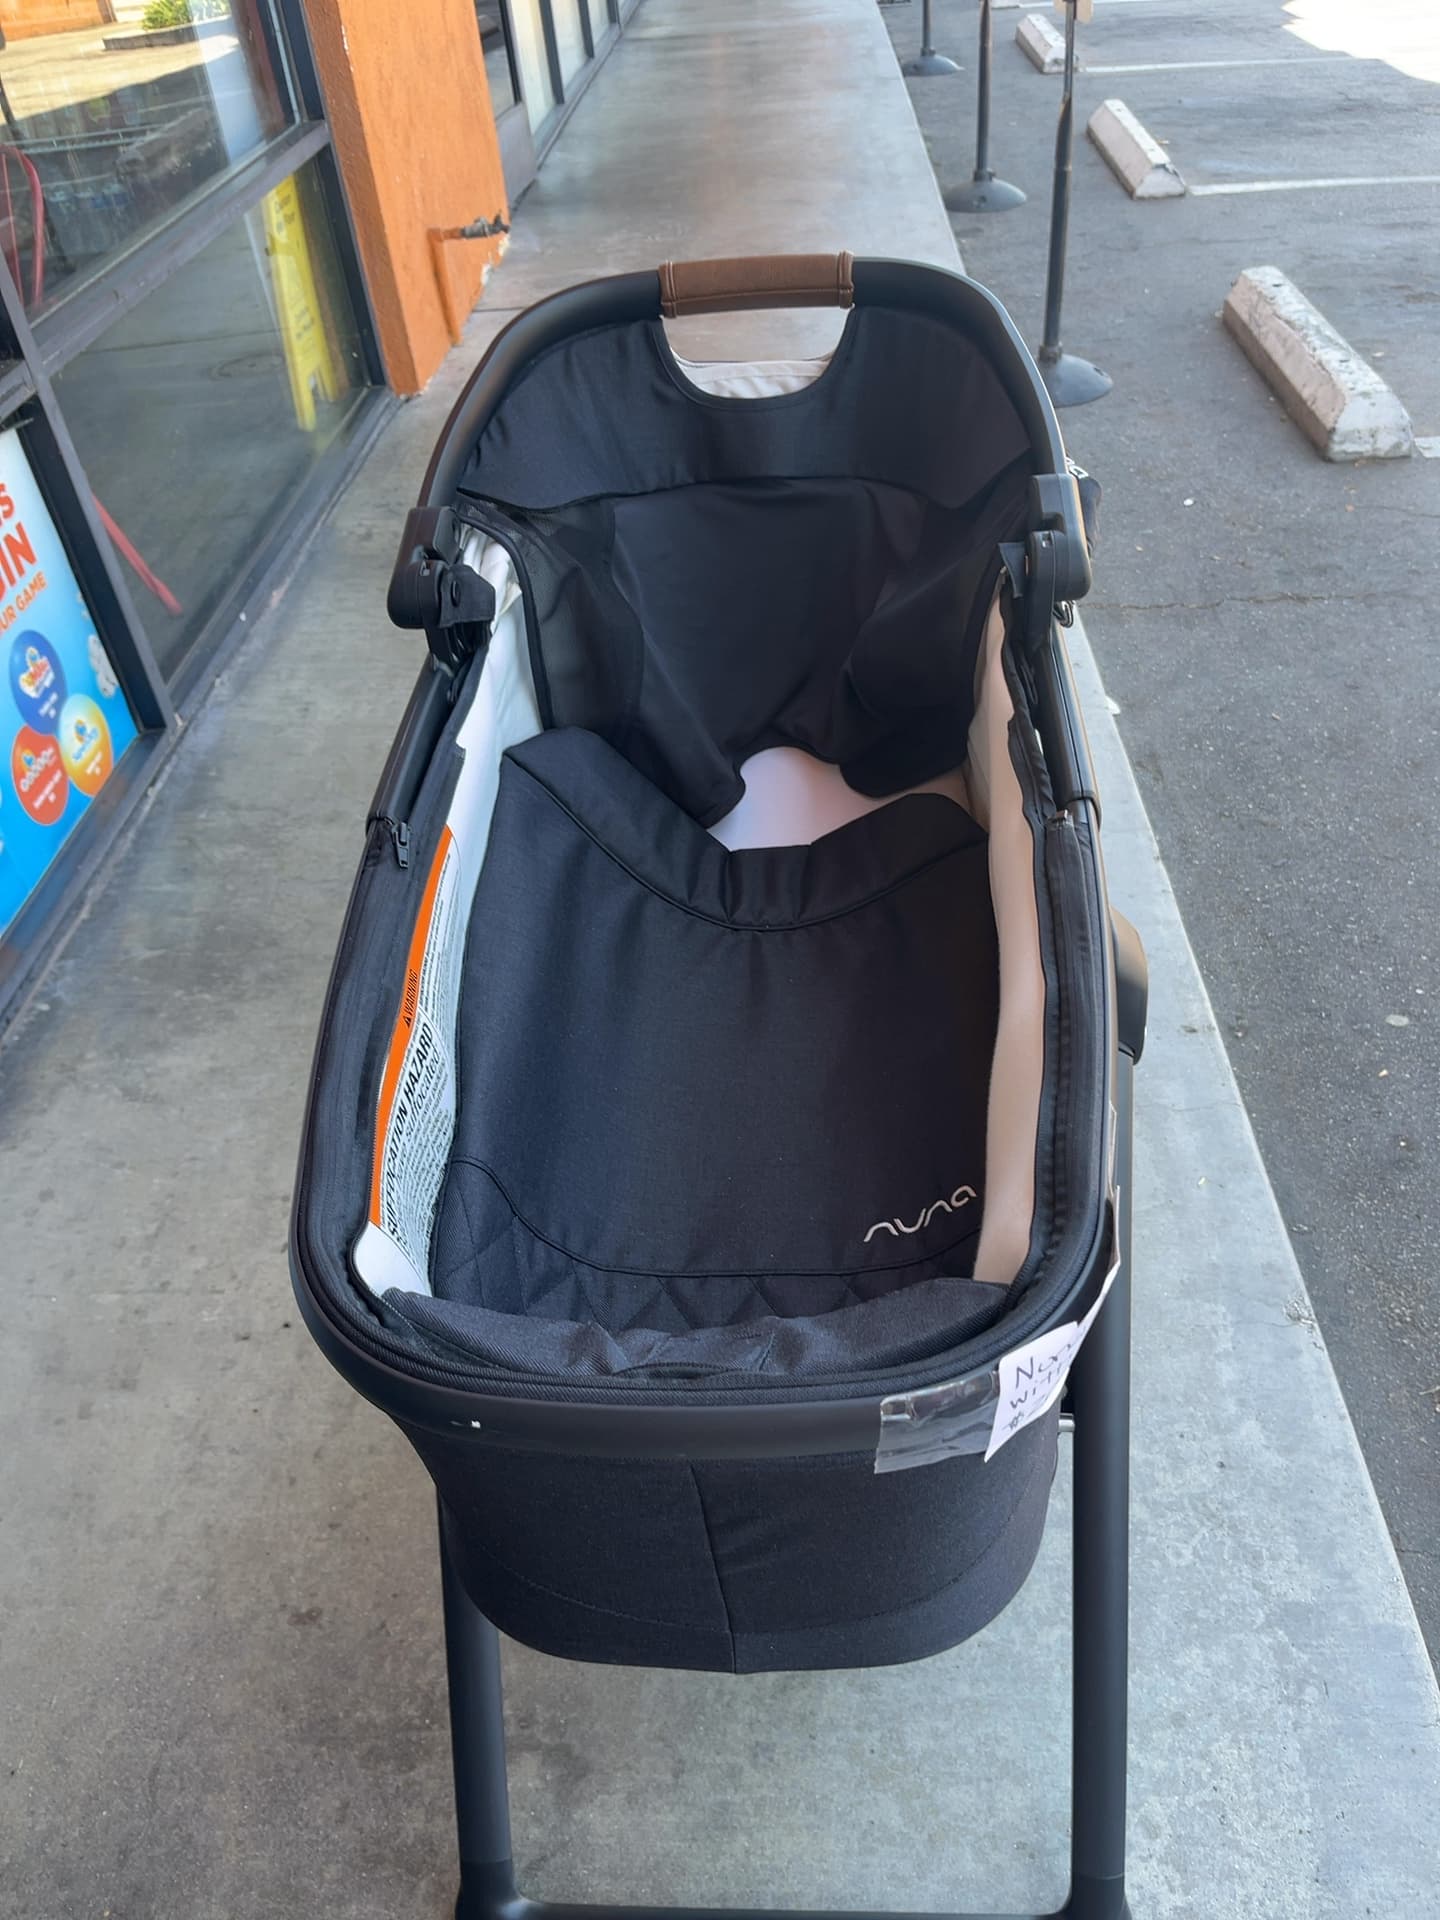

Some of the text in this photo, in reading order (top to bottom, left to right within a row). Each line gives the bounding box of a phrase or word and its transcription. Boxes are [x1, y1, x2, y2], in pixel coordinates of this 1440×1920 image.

[0, 521, 37, 598] IN
[15, 571, 47, 612] GAME
[404, 968, 418, 1017] WARNING
[386, 1100, 408, 1237] SUFFOCATION
[404, 1022, 433, 1105] HAZARD
[863, 1185, 977, 1242] nuna
